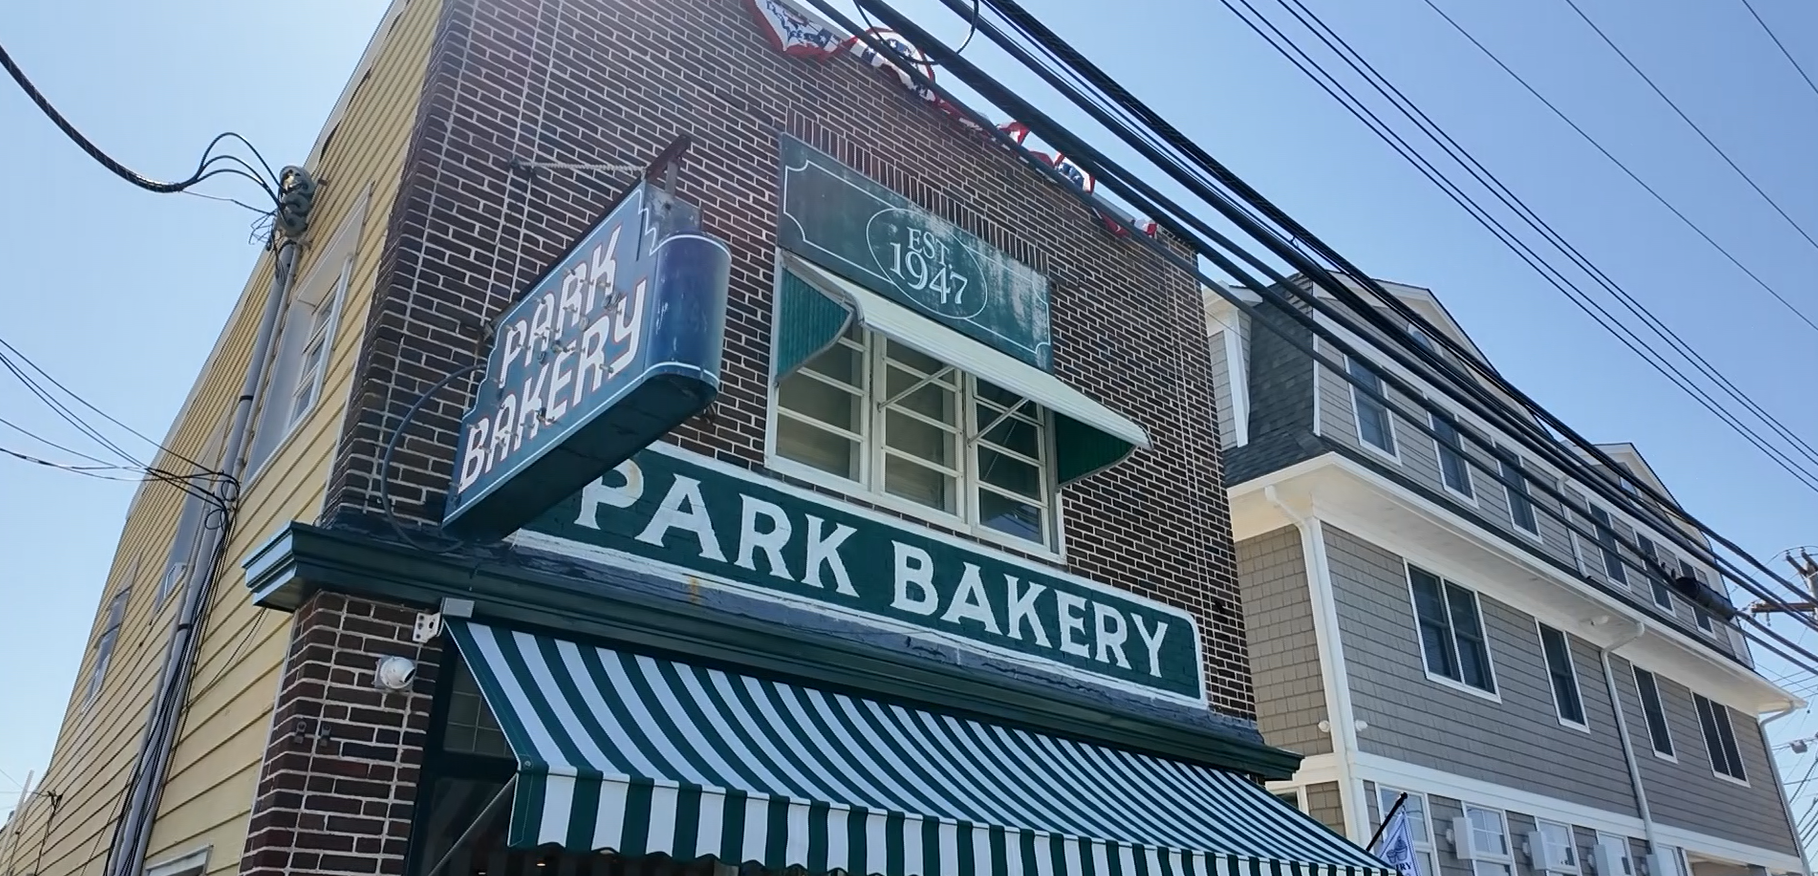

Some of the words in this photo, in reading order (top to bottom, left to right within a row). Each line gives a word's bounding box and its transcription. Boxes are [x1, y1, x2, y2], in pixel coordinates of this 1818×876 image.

[499, 224, 622, 389] PARK
[890, 242, 968, 304] 1947
[907, 226, 953, 269] EST.
[457, 279, 648, 494] BAKERY
[574, 458, 860, 598] PARK
[890, 541, 1168, 678] BAKERY
